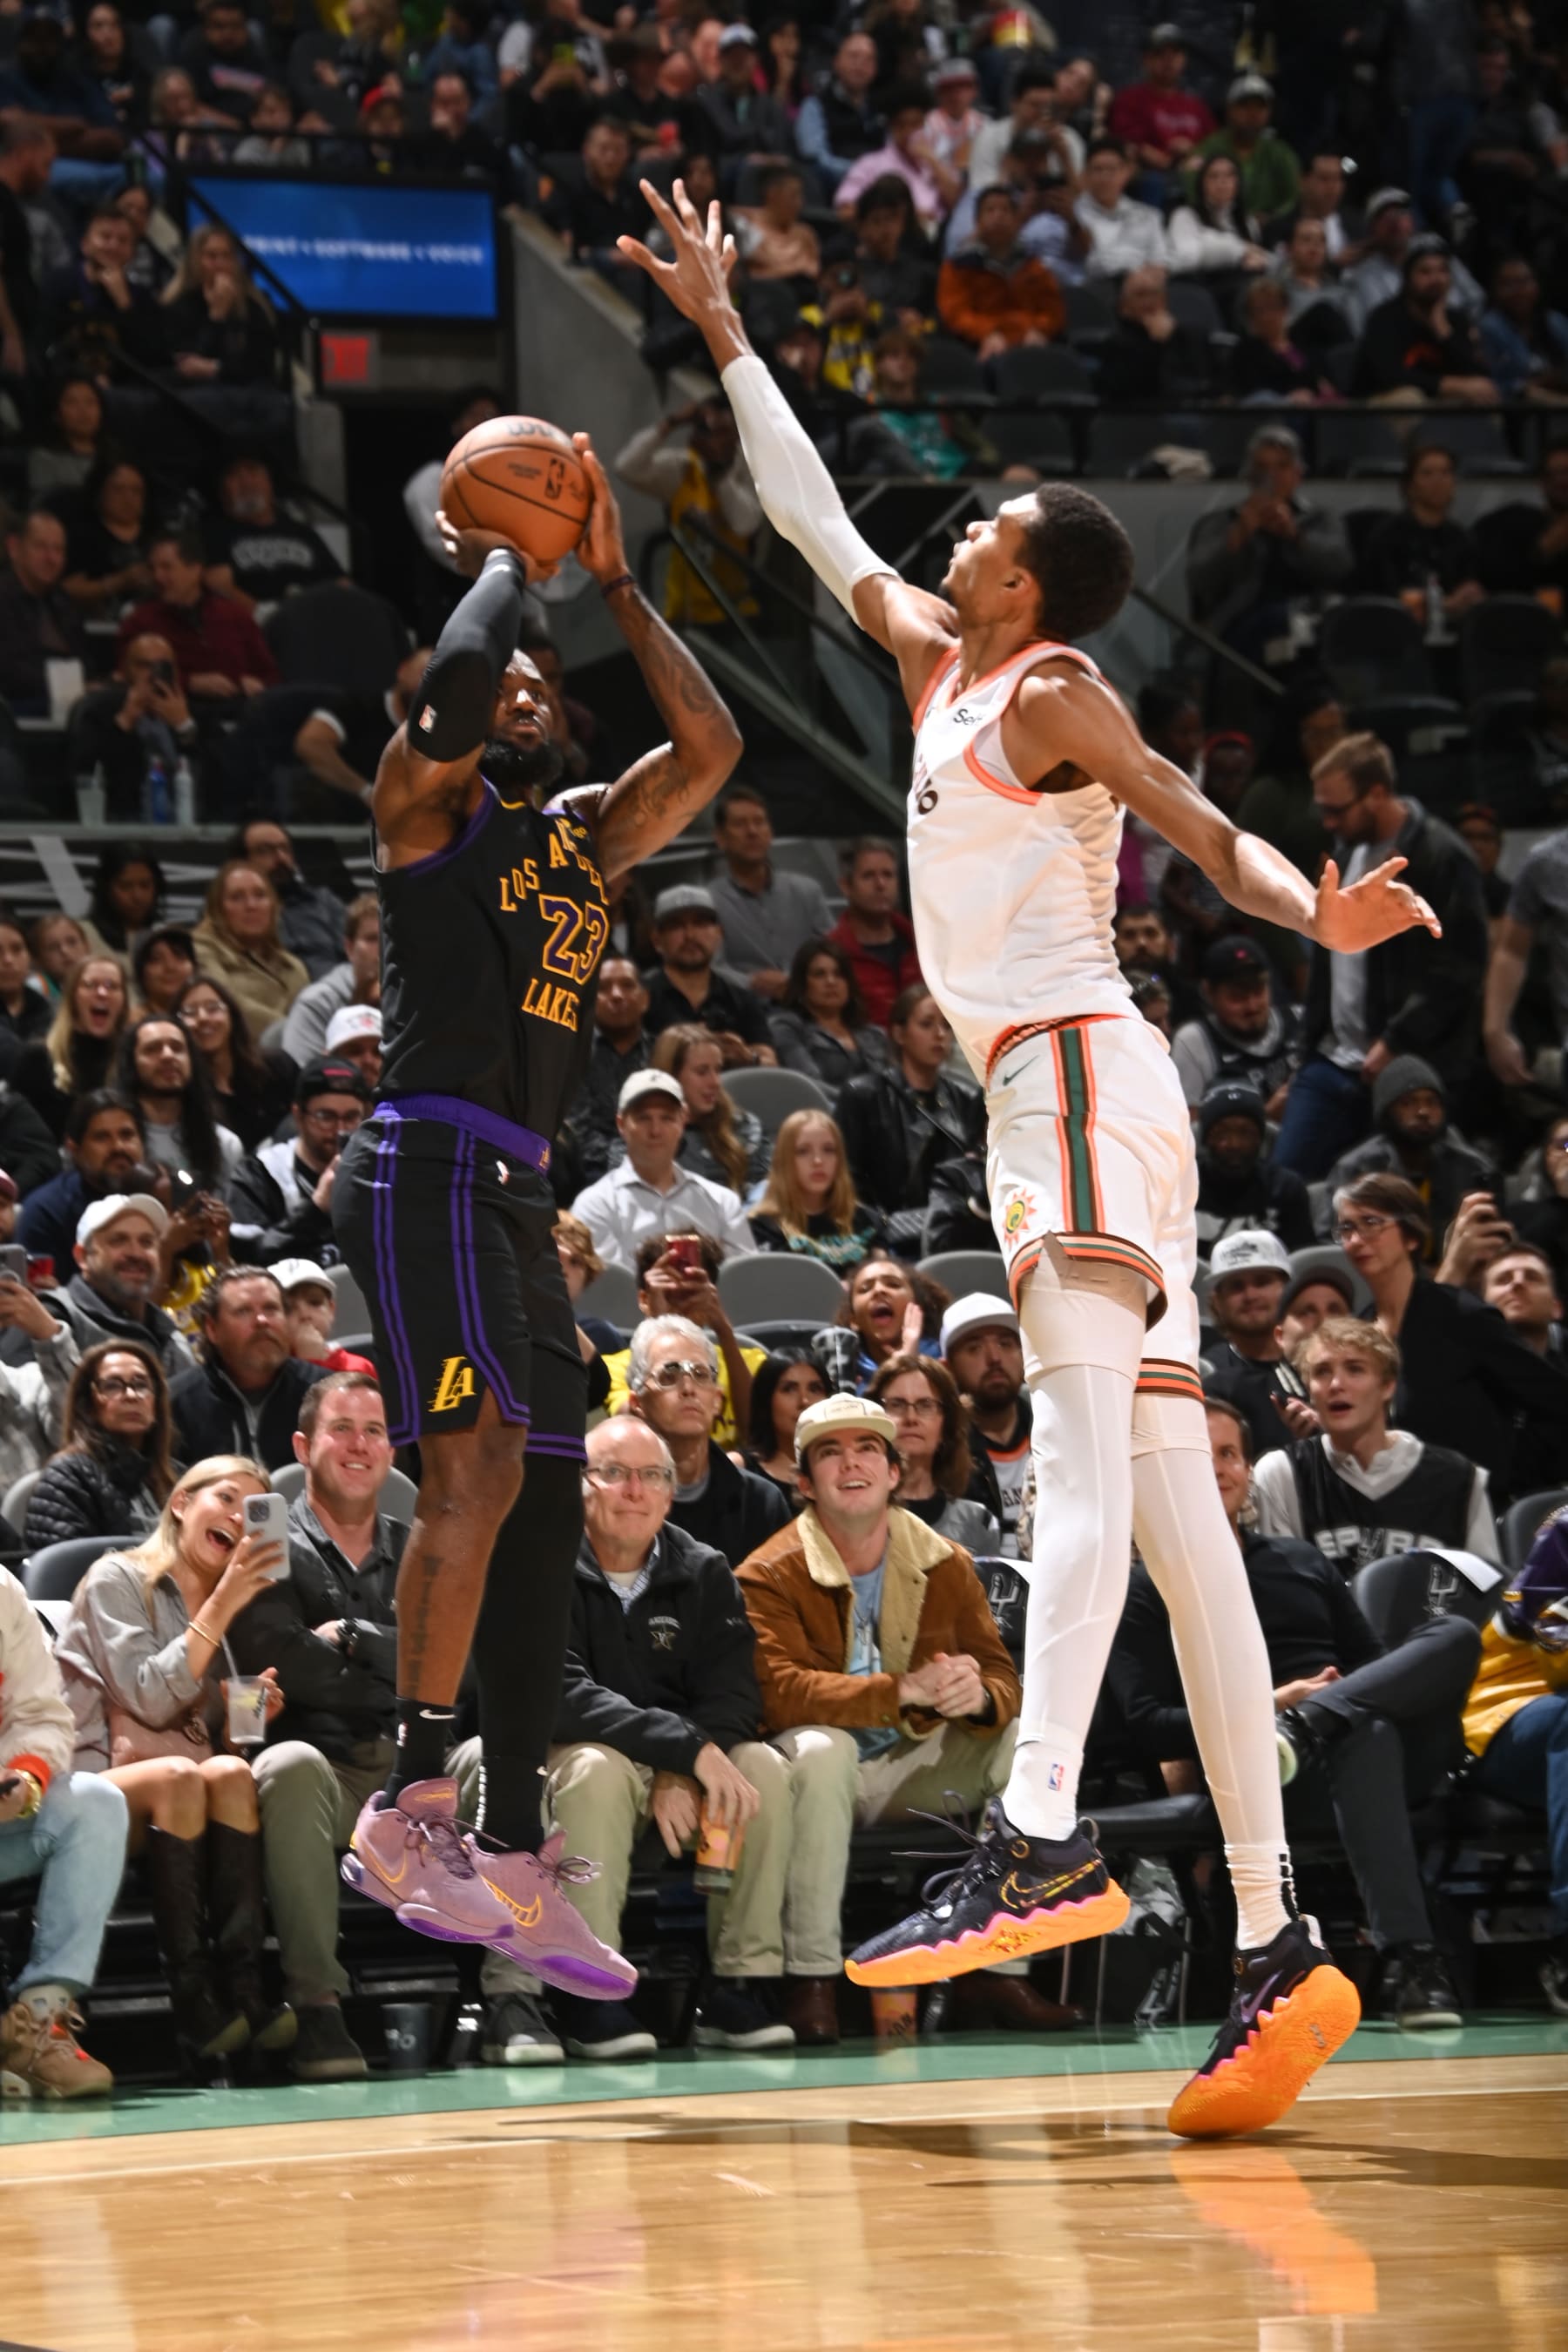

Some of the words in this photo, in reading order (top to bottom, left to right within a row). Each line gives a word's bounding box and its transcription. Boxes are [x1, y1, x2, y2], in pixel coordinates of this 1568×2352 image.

[499, 857, 540, 913] LOS
[538, 893, 610, 986] 23
[427, 1355, 476, 1413] LA
